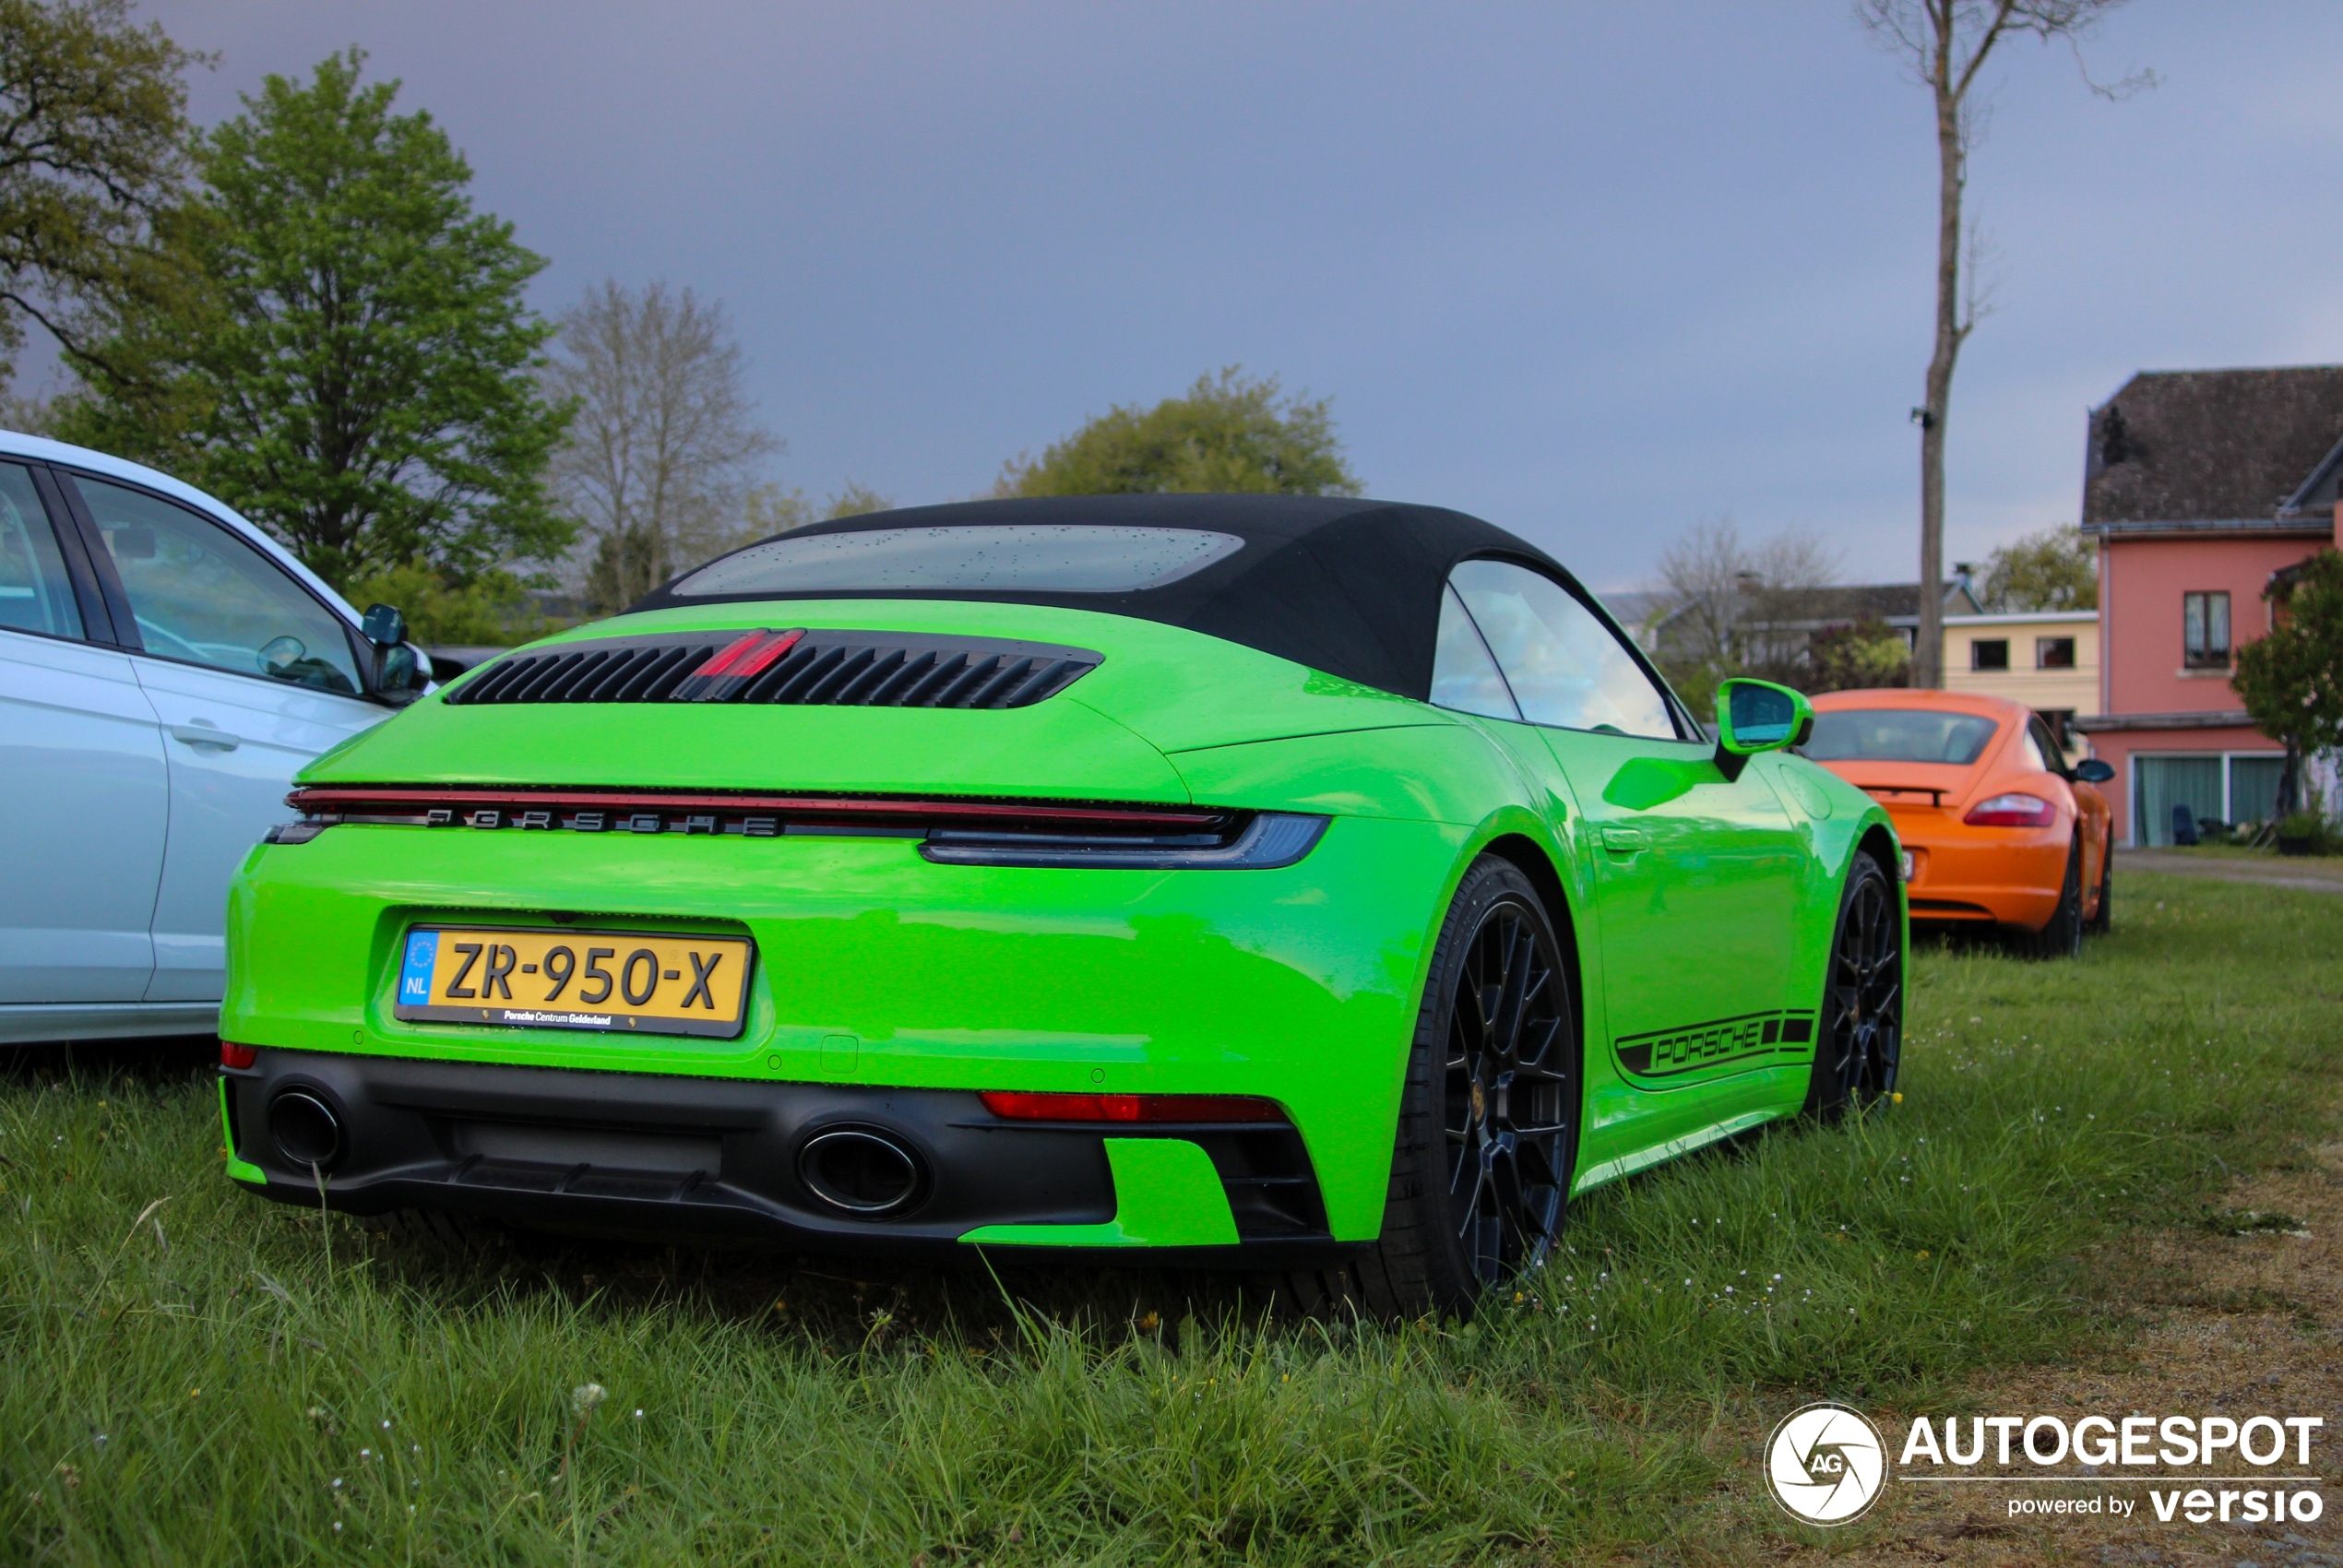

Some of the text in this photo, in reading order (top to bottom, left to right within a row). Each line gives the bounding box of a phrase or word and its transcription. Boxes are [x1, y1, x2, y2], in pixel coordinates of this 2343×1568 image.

[426, 809, 779, 837] PORSCHE
[406, 977, 426, 994] NL
[446, 942, 722, 1009] ZR-950-X
[504, 1010, 612, 1025] Porsche Centrum Gelderland
[1656, 1022, 1760, 1067] PORSCHE
